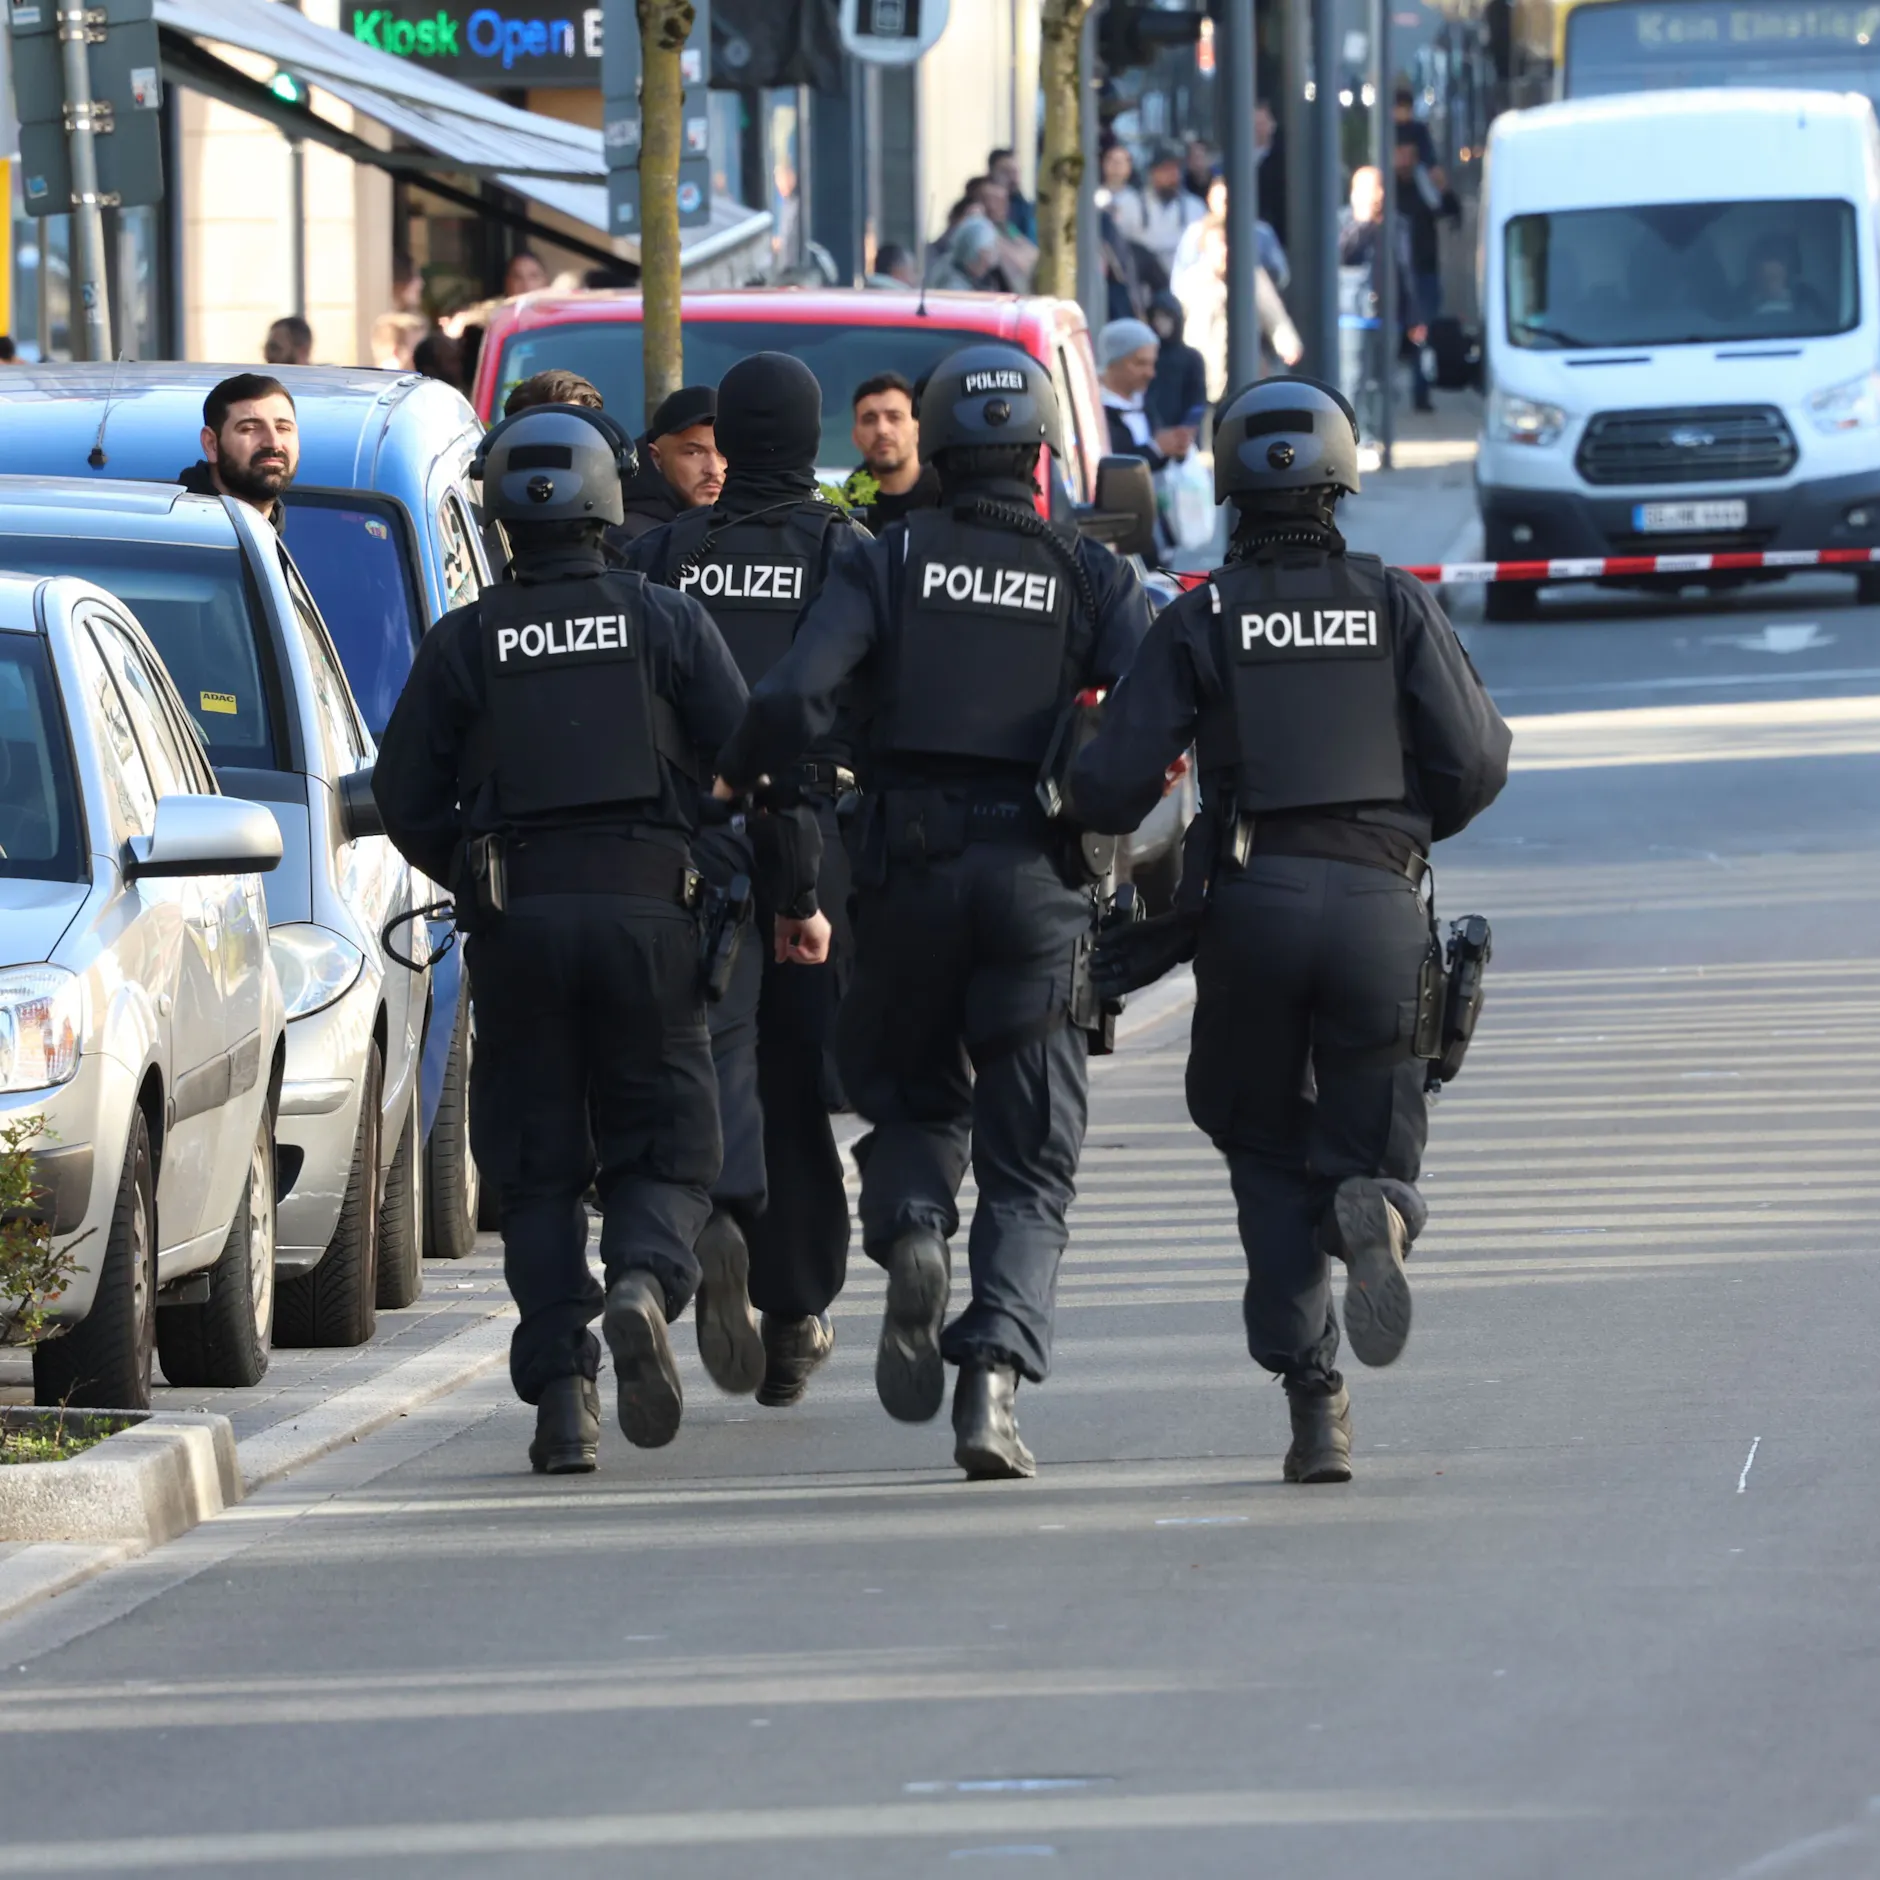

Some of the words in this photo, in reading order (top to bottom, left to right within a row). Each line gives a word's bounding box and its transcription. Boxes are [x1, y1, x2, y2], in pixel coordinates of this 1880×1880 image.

[354, 9, 459, 57] Kiosk
[467, 8, 575, 69] Open
[966, 370, 1022, 392] POLIZEI
[680, 563, 803, 600] POLIZEI
[922, 561, 1057, 613] POLIZEI
[497, 614, 628, 662] POLIZEI
[1240, 610, 1378, 650] POLIZEI
[203, 693, 234, 703] ADAC
